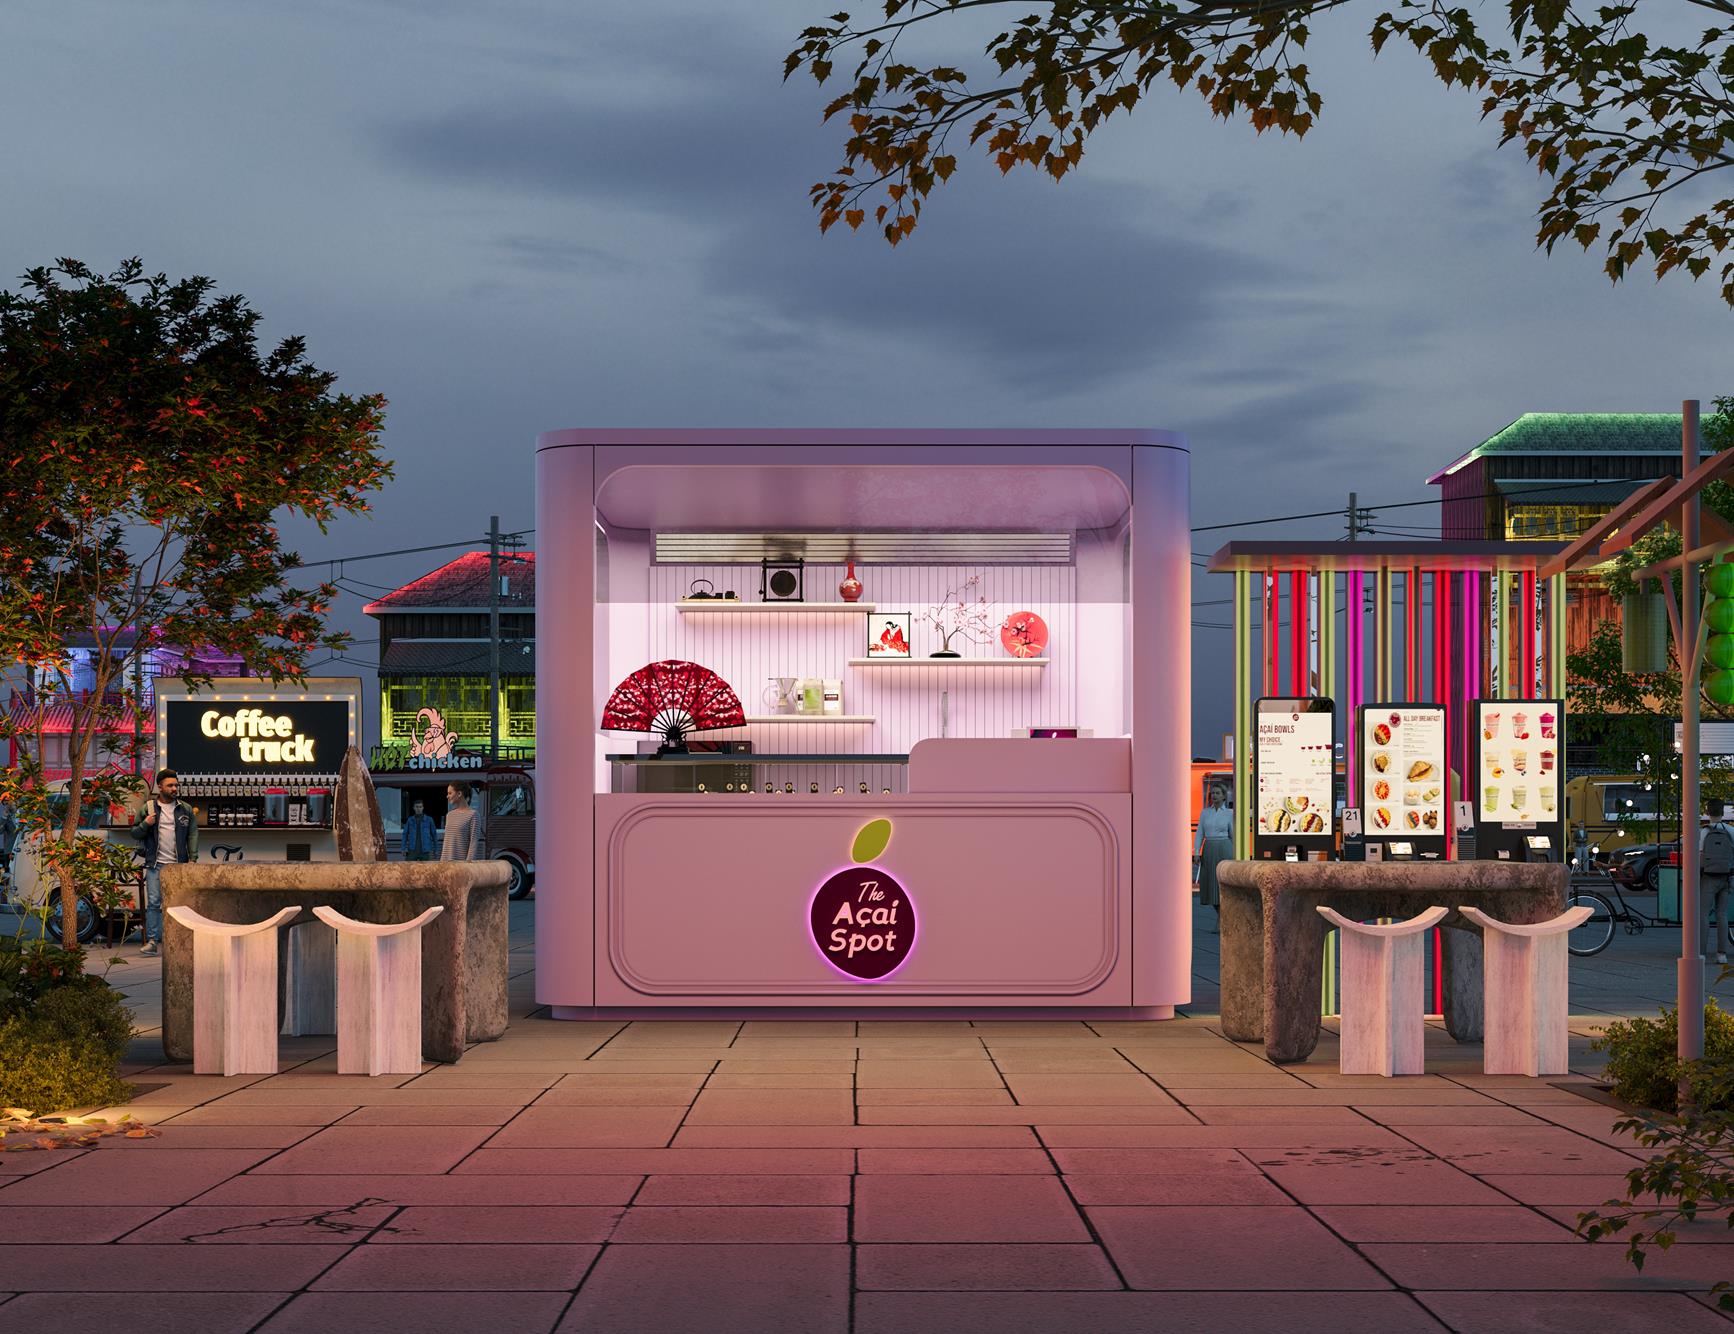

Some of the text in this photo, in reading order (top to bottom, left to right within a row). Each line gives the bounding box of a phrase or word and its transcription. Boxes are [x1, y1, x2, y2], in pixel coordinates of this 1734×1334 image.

[200, 709, 293, 738] Coffee
[1274, 725, 1295, 734] BOWLS
[239, 734, 315, 763] truck
[370, 743, 483, 771] HOT chicken
[1345, 811, 1358, 821] 21
[1460, 805, 1466, 817] 1
[857, 881, 886, 903] The
[832, 899, 900, 928] Açai
[828, 928, 897, 959] Spot
